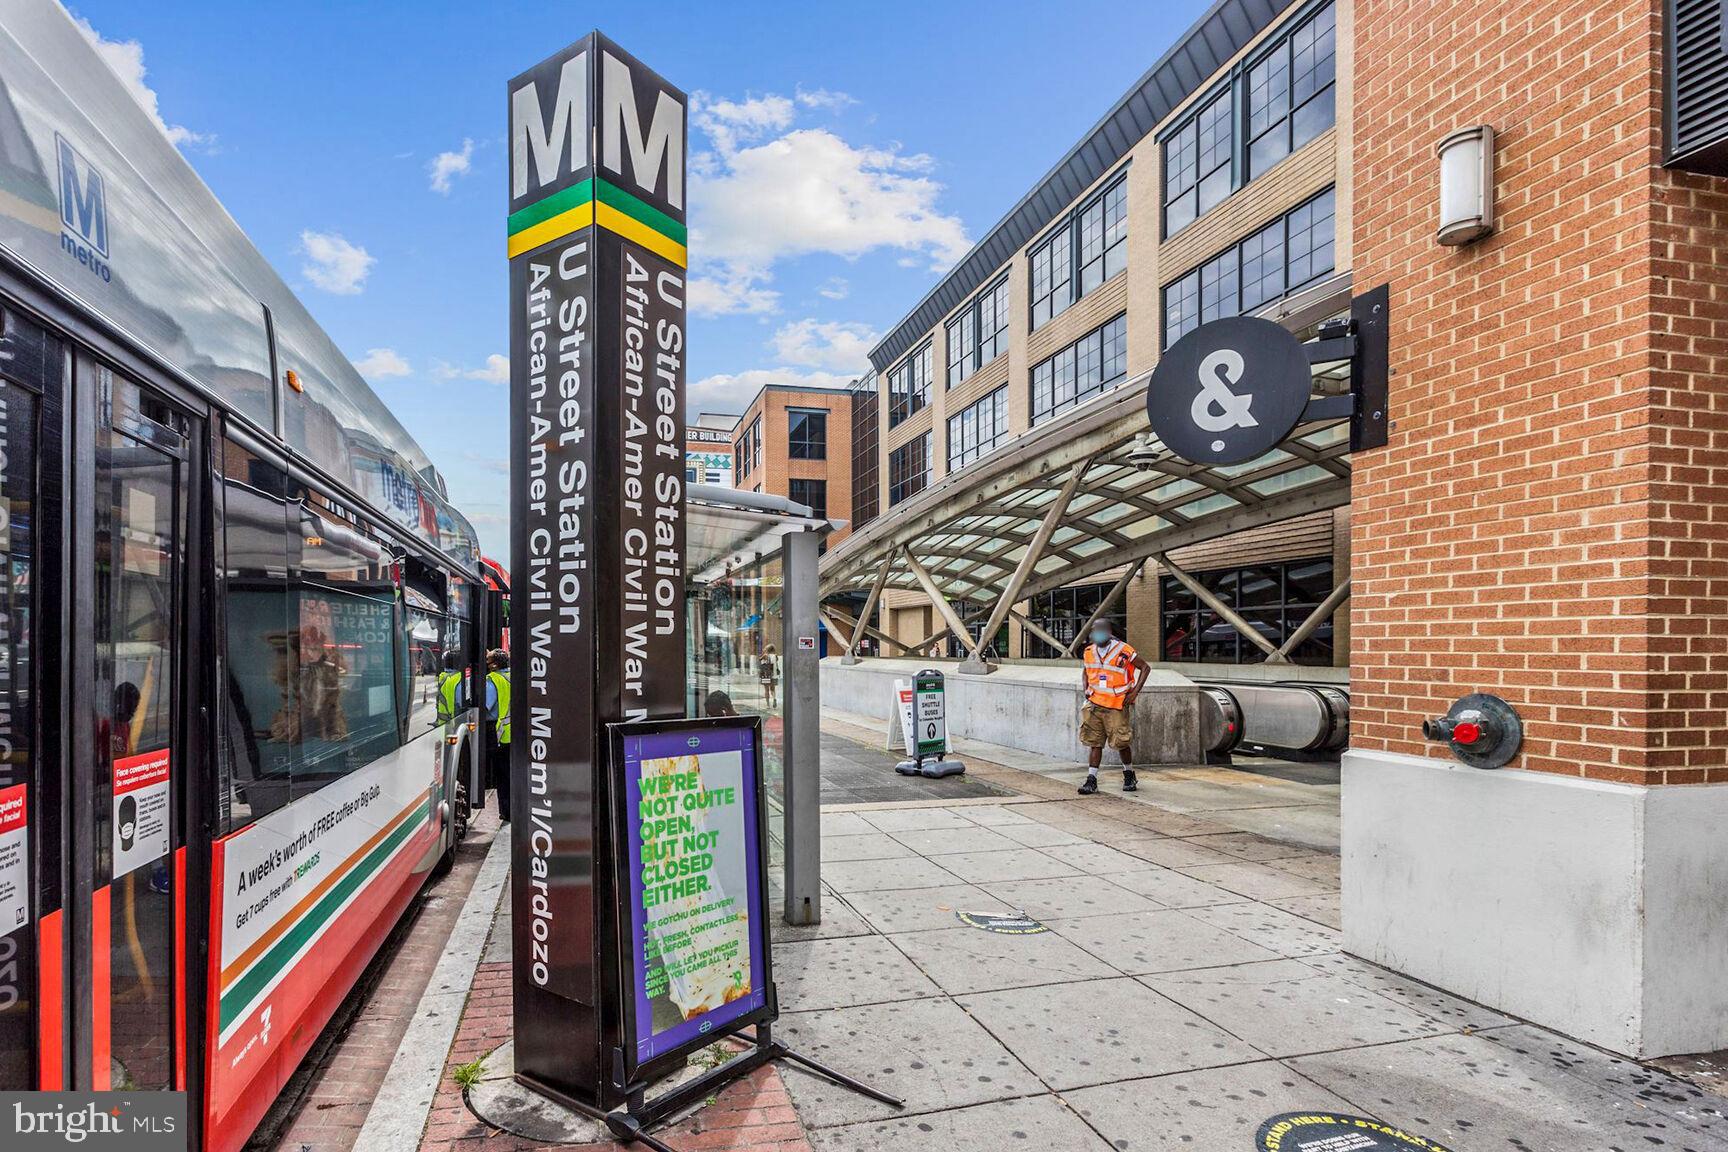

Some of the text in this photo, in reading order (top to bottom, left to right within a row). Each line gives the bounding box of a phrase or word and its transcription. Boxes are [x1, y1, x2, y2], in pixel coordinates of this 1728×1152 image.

[512, 50, 587, 200] M
[603, 50, 683, 211] M
[59, 140, 105, 252] M
[60, 231, 111, 283] metro
[624, 253, 649, 517] African-Amer
[1191, 349, 1259, 432] &
[559, 241, 587, 635] U Street Station
[654, 270, 683, 635] U Street Station
[700, 431, 732, 442] BUILDING
[624, 528, 648, 612] Civil
[530, 263, 553, 986] African-Amer Civil War Mem'l/Cardozo
[625, 621, 648, 696] War
[116, 757, 168, 777] Face covering required
[637, 772, 698, 797] WE'RE
[4, 810, 20, 823] facial
[639, 787, 735, 820] NOT QUITE
[237, 871, 247, 897] A
[248, 849, 282, 887] week's
[282, 831, 307, 862] worth
[308, 824, 318, 844] of
[317, 811, 335, 838] FREE
[336, 802, 354, 824] coffee
[354, 799, 361, 812] or
[360, 791, 369, 807] Big
[639, 815, 695, 841] OPEN,
[640, 830, 719, 864] BUT NOT
[641, 853, 713, 886] CLOSED
[236, 909, 249, 929] Get
[250, 905, 255, 918] 7
[254, 895, 269, 914] cups
[270, 885, 281, 901] free
[282, 875, 294, 891] with
[643, 875, 712, 909] EITHER.
[644, 896, 735, 931] WE GOTCHU ON DELIVERY
[690, 912, 739, 935] CONTACTLESS
[645, 940, 739, 980] AND WILL LET YOU PICKUP
[662, 938, 692, 954] BEFORE
[644, 949, 738, 989] SINCE YOU CAME ALL THIS
[1265, 1121, 1293, 1150] STAND
[1289, 1116, 1337, 1126] HERE
